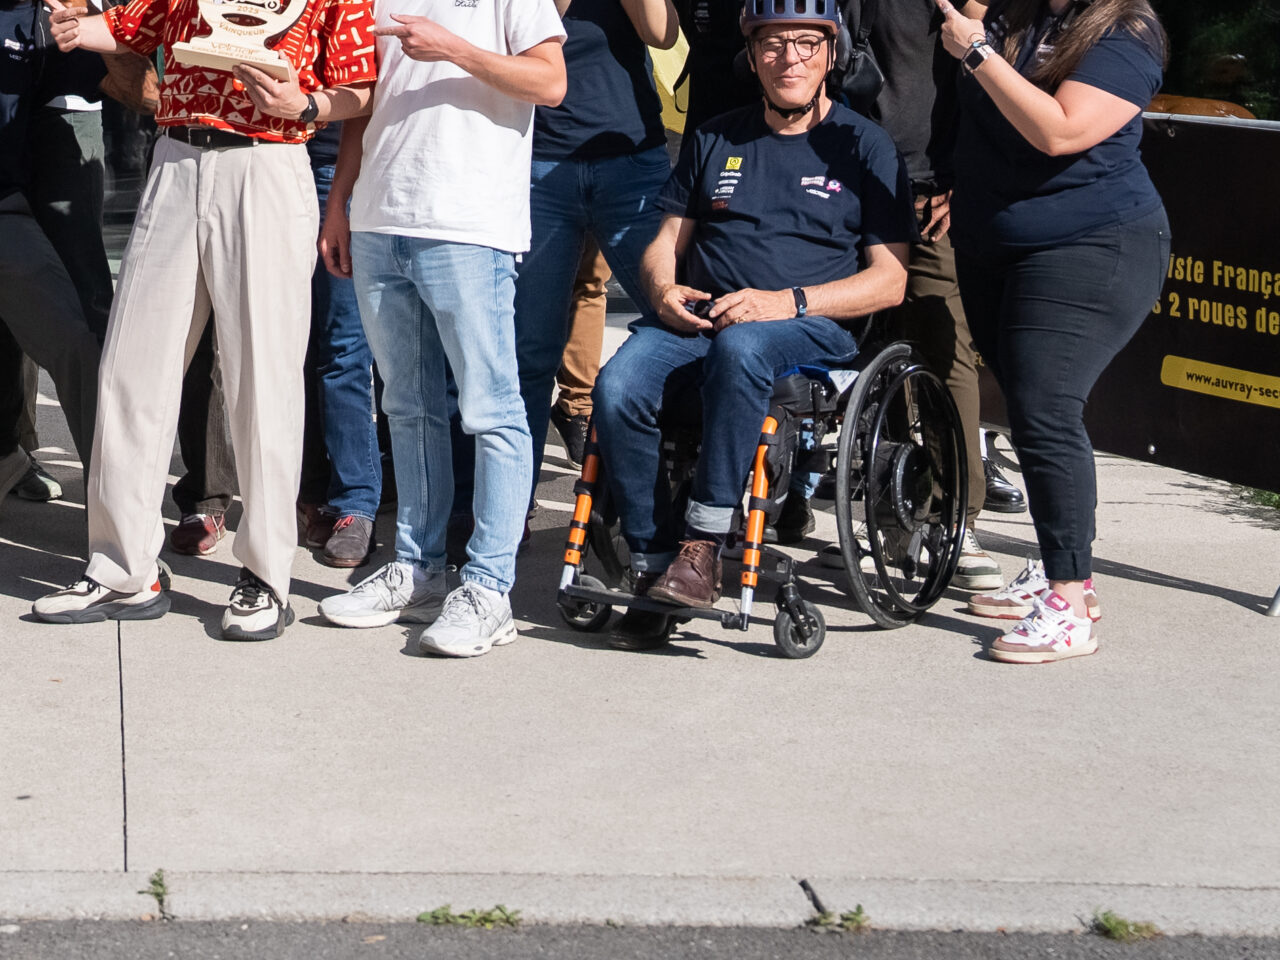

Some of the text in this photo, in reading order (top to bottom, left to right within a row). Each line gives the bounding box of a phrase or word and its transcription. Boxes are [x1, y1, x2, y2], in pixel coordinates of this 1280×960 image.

[1167, 253, 1205, 284] iste
[1168, 292, 1181, 317] 2
[1188, 298, 1248, 330] roues
[1185, 371, 1280, 400] www.auvray-sec
